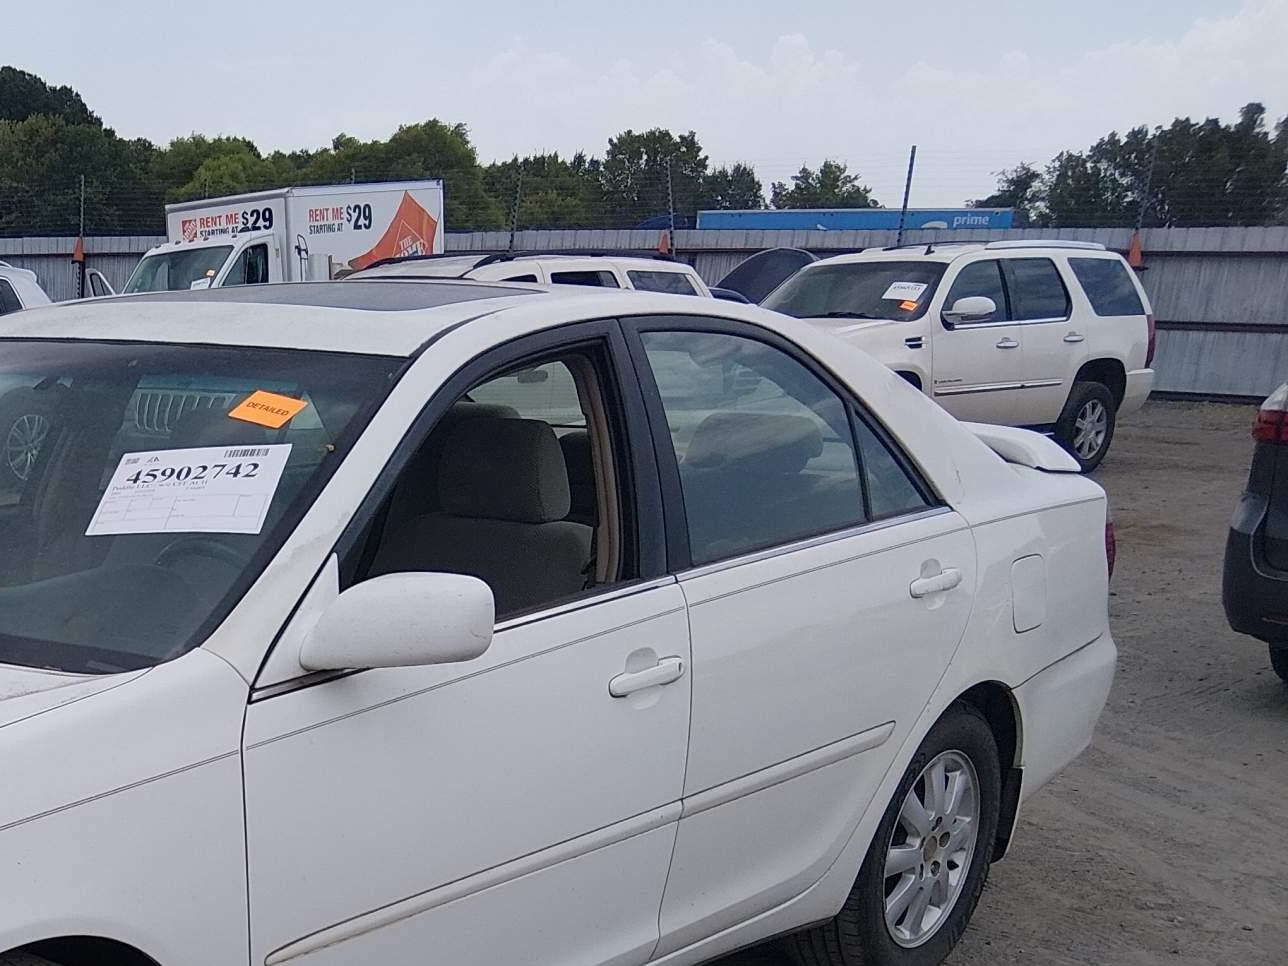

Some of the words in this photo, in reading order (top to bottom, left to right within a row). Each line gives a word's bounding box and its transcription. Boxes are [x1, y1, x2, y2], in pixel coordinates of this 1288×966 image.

[199, 215, 223, 229] RENT
[225, 212, 239, 226] ME
[242, 208, 272, 230] $29
[309, 207, 329, 222] RENT
[331, 206, 344, 221] ME
[346, 204, 371, 229] $29
[954, 214, 989, 227] prime
[200, 227, 230, 236] STARTING
[231, 225, 240, 234] AT
[309, 224, 335, 235] STARTING
[336, 222, 344, 233] AT
[400, 235, 413, 251] THE
[246, 401, 289, 416] DETAILED
[127, 463, 260, 484] 45902742
